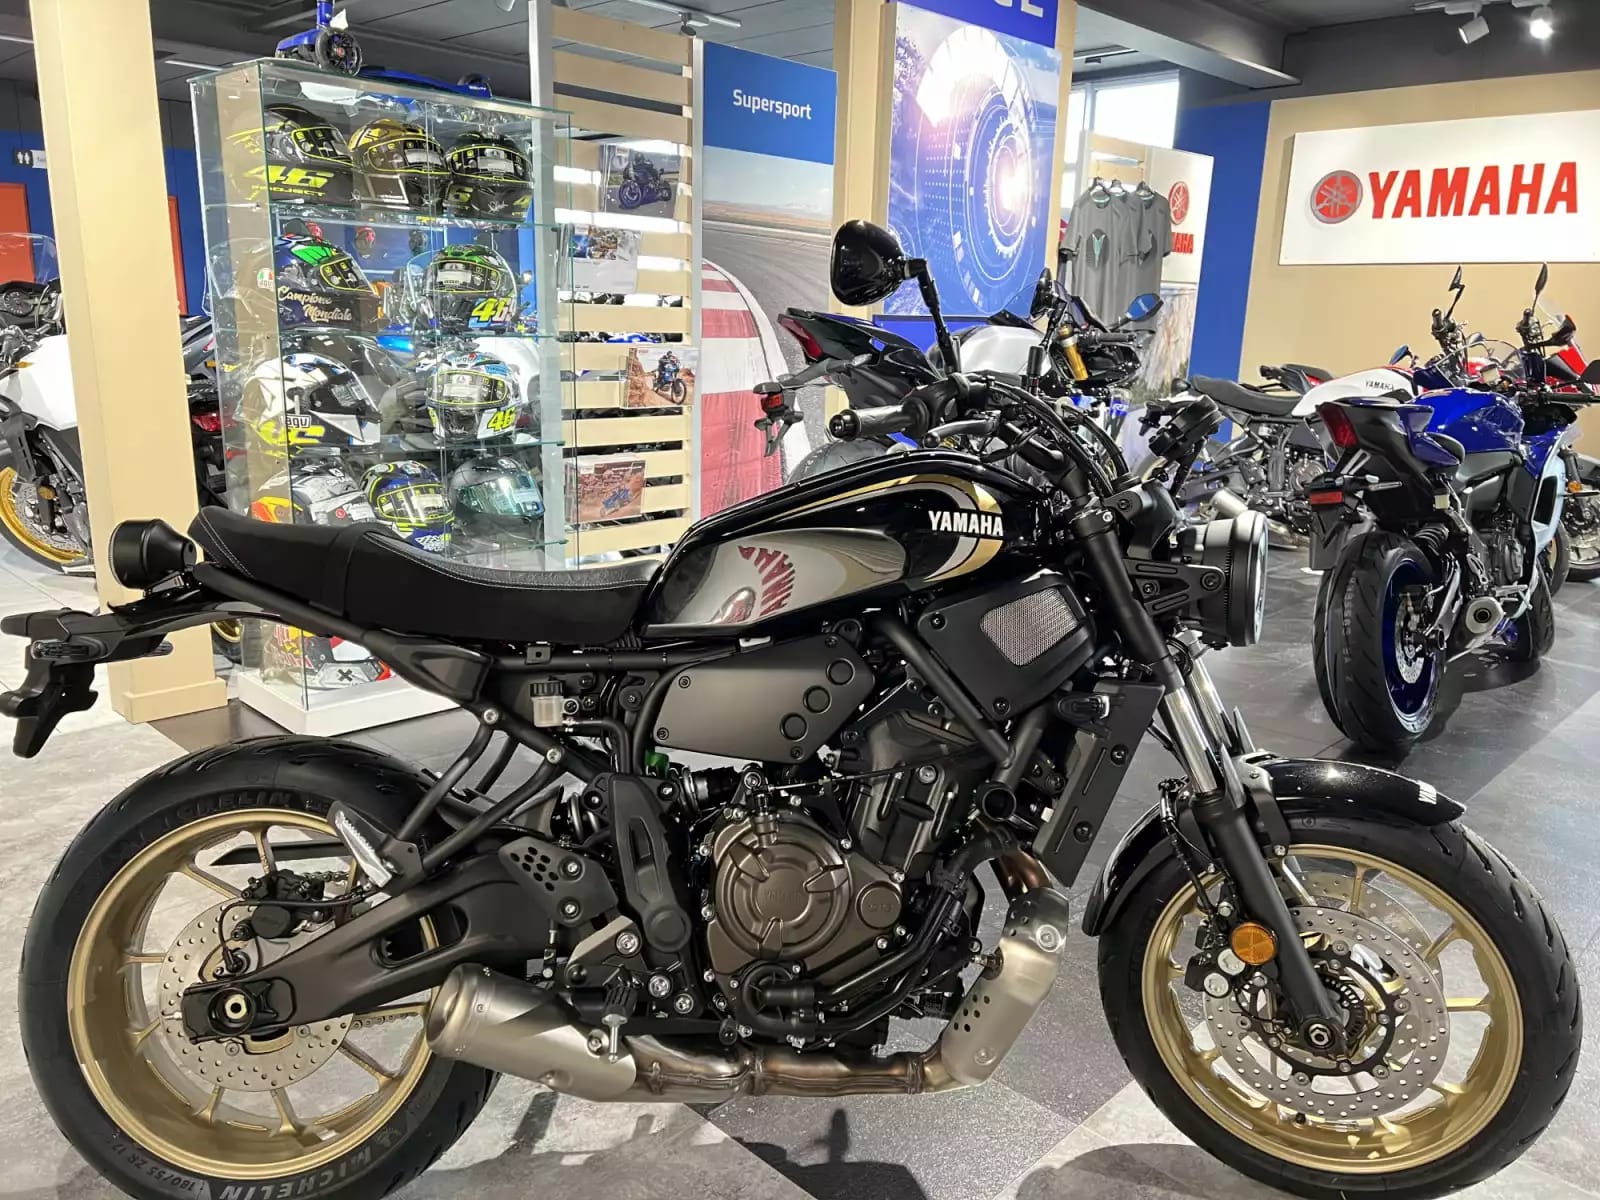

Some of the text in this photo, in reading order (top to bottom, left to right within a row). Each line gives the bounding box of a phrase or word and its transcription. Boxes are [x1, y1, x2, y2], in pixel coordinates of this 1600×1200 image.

[732, 88, 812, 119] Supersport
[243, 165, 334, 188] 46
[1368, 161, 1578, 219] YAMAHA
[302, 303, 353, 323] Mondiale
[487, 406, 517, 432] 46
[927, 510, 1004, 537] YAMAHA
[145, 1165, 197, 1191] 180/55
[218, 1149, 372, 1200] MICHELIN
